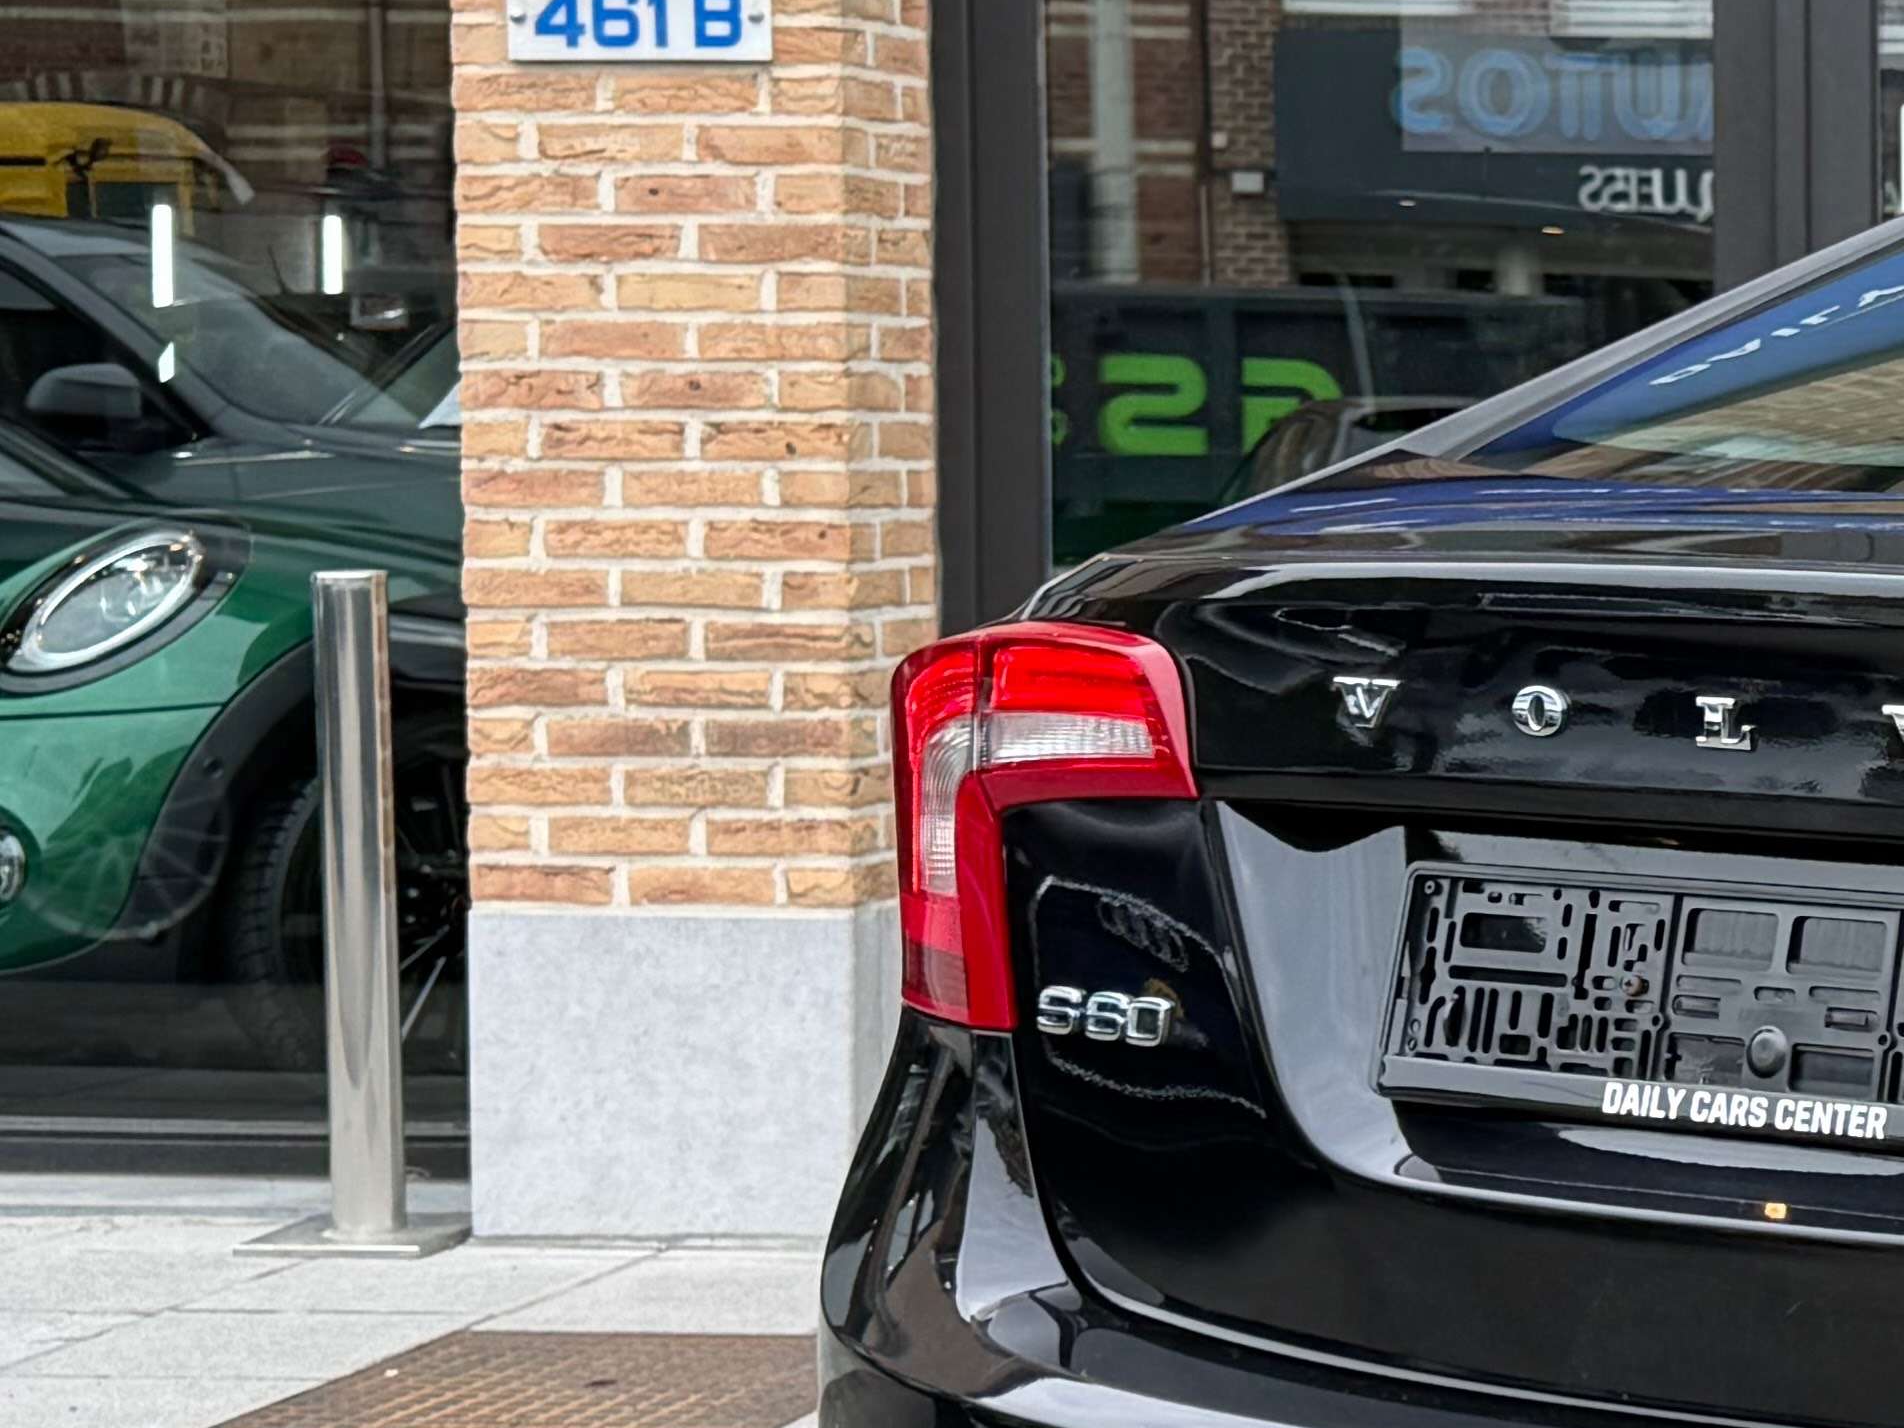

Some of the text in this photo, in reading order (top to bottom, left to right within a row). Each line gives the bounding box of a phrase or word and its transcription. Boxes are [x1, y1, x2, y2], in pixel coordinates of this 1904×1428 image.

[1036, 984, 1176, 1047] S60
[1601, 1081, 1888, 1140] DAILY CARS CENTER
